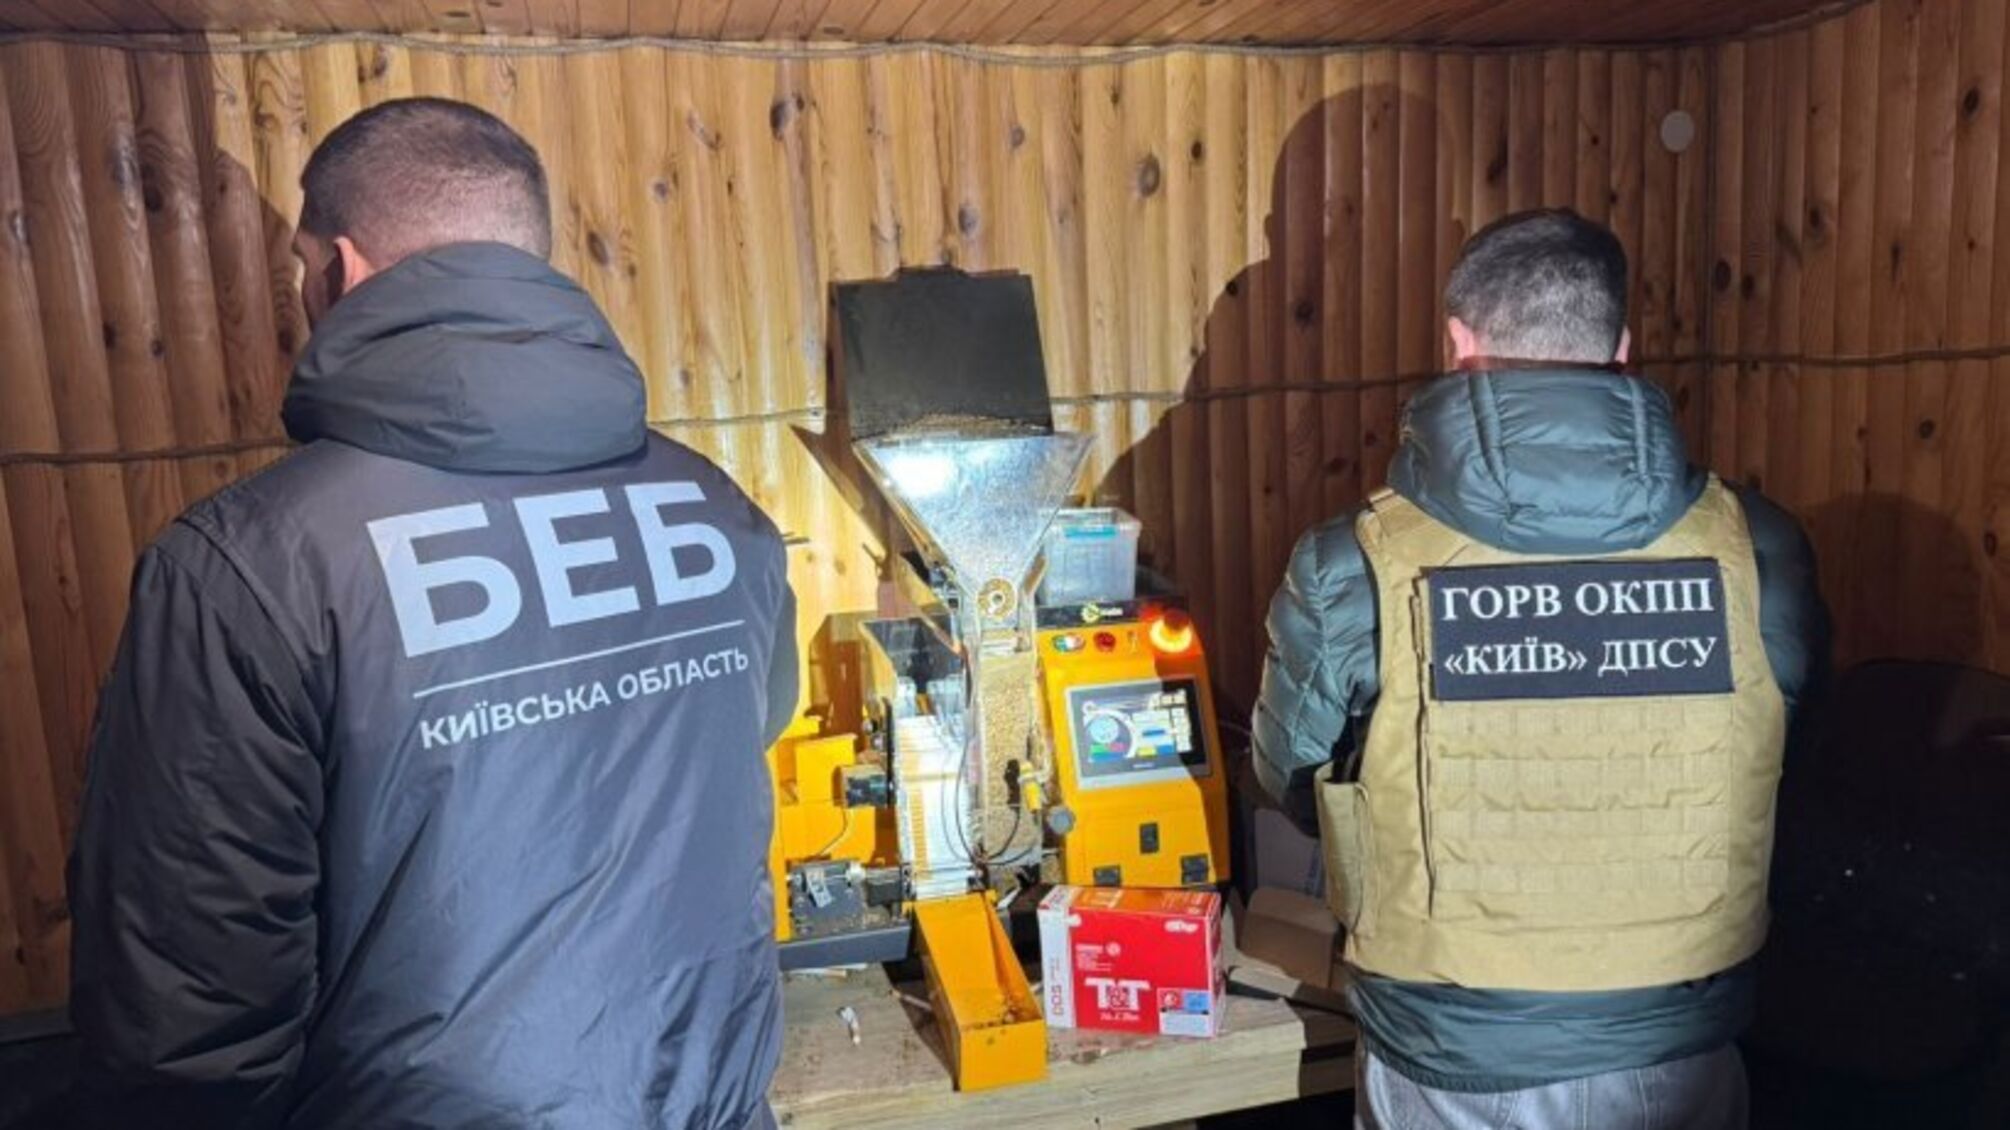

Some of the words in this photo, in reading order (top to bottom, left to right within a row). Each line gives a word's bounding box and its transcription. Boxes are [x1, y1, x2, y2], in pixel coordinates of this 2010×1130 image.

[366, 481, 736, 658] БЕБ
[1441, 584, 1562, 621] ГОРВ
[1575, 577, 1715, 616] ОКПП
[1444, 636, 1588, 675] «КИЇВ»
[1598, 637, 1717, 677] ДПСУ
[420, 682, 612, 749] КИЇВСЬКА
[617, 647, 749, 697] ОБЛАСТЬ
